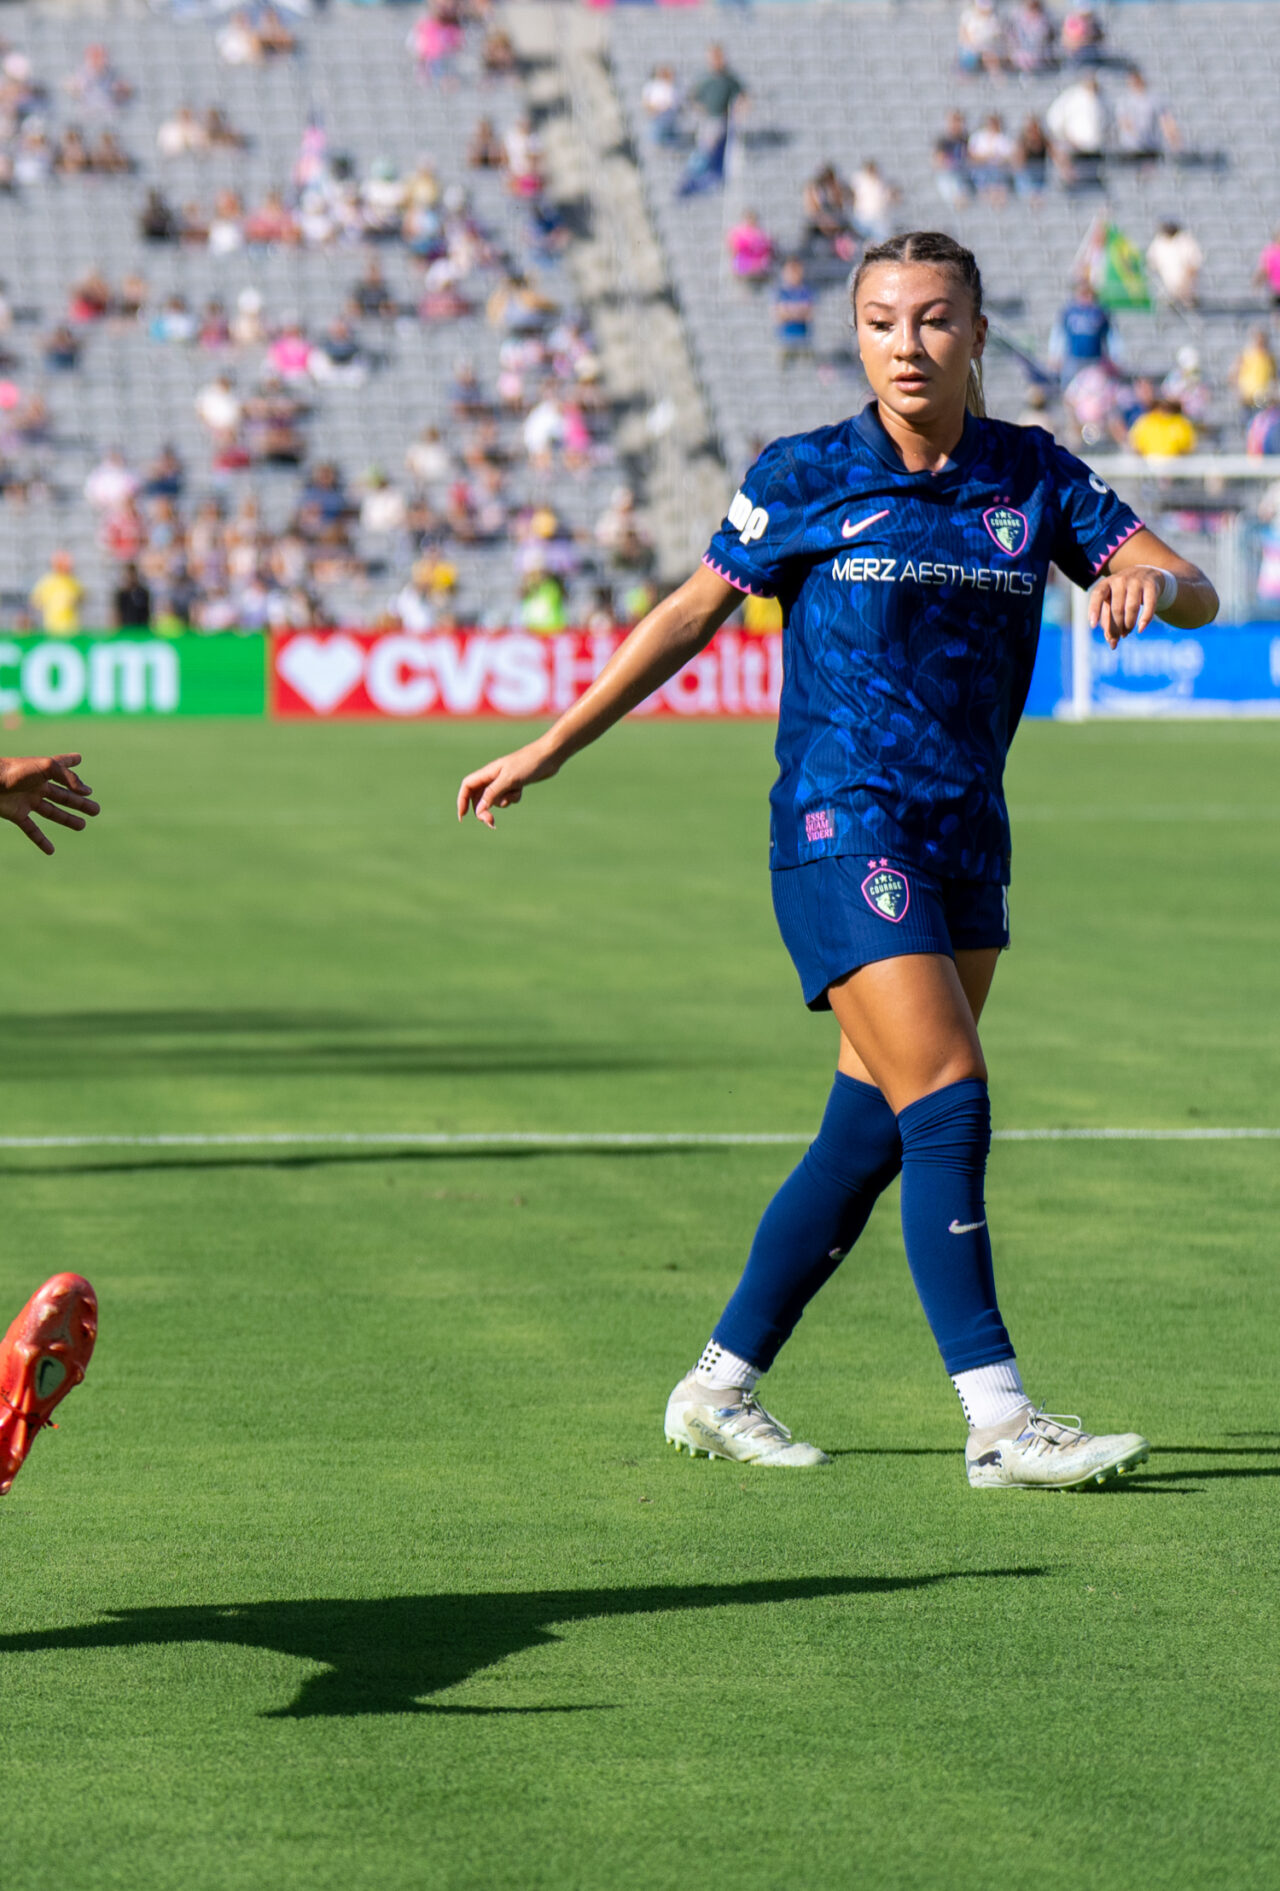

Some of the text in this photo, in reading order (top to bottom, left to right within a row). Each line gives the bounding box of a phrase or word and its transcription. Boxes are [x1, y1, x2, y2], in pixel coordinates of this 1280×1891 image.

[831, 557, 1035, 595] MERZ AESTHETICS
[364, 632, 551, 717] CVS
